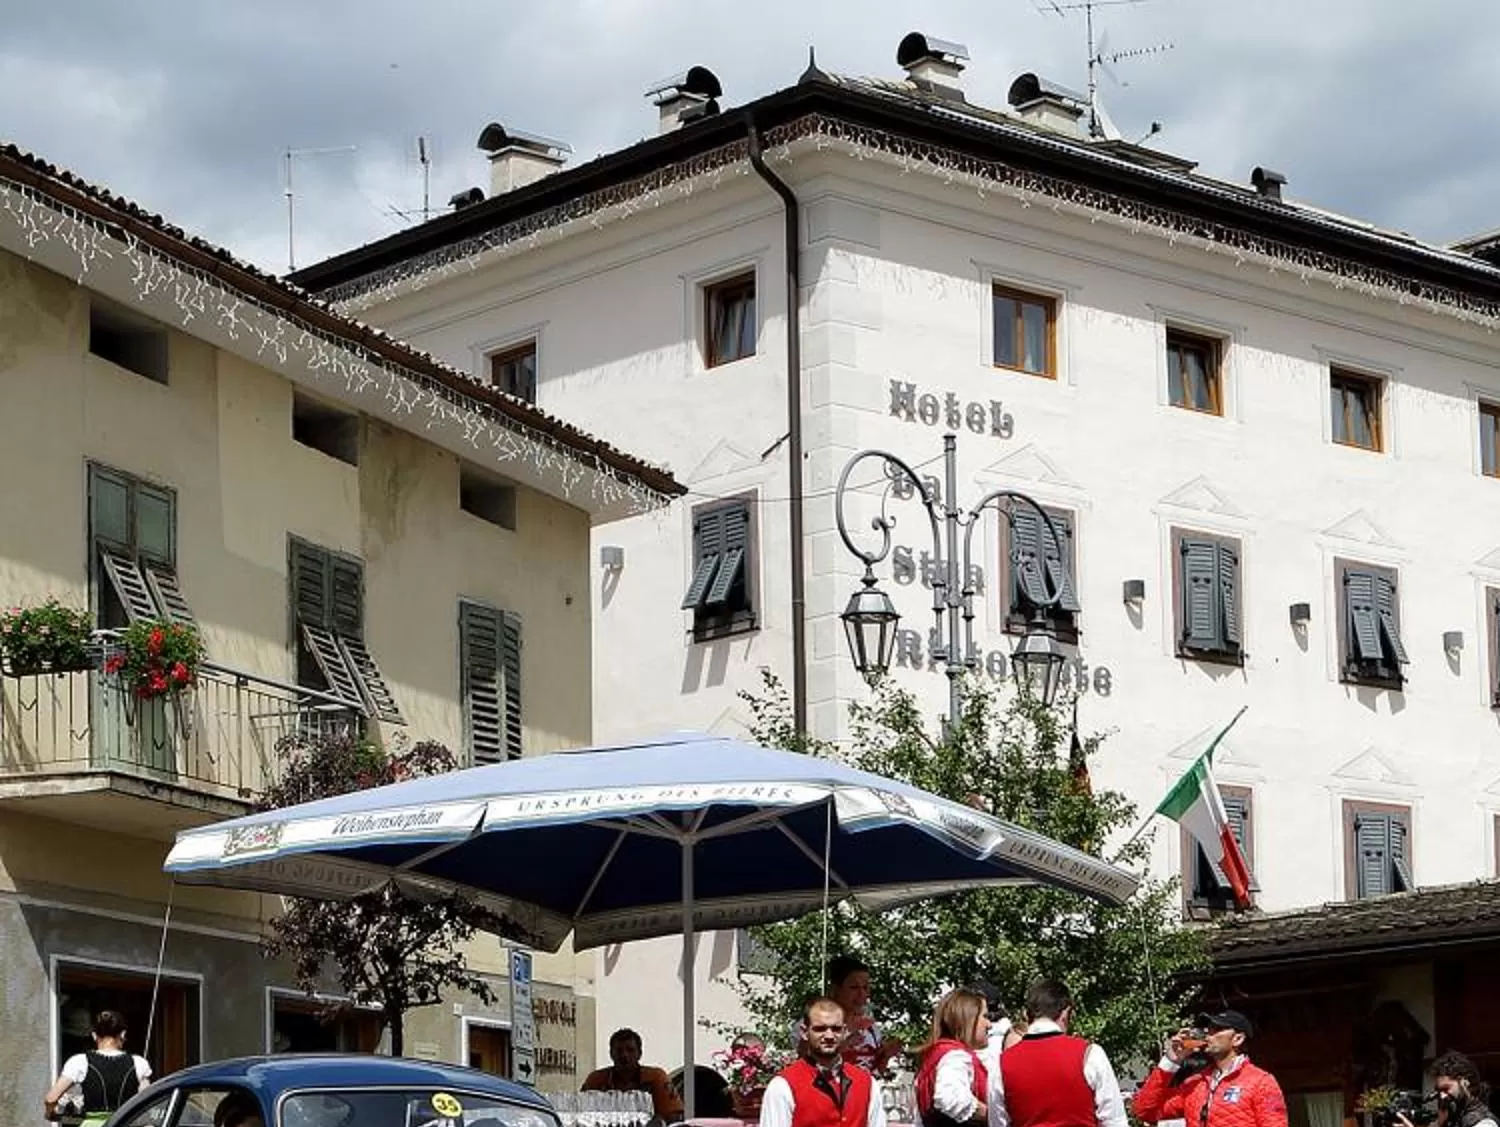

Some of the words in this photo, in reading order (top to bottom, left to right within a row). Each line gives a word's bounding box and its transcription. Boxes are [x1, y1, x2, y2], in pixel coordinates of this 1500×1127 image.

[889, 378, 1015, 440] Hotel
[892, 545, 985, 597] Sta
[895, 625, 1112, 698] Ritonte
[435, 1097, 459, 1113] 35
